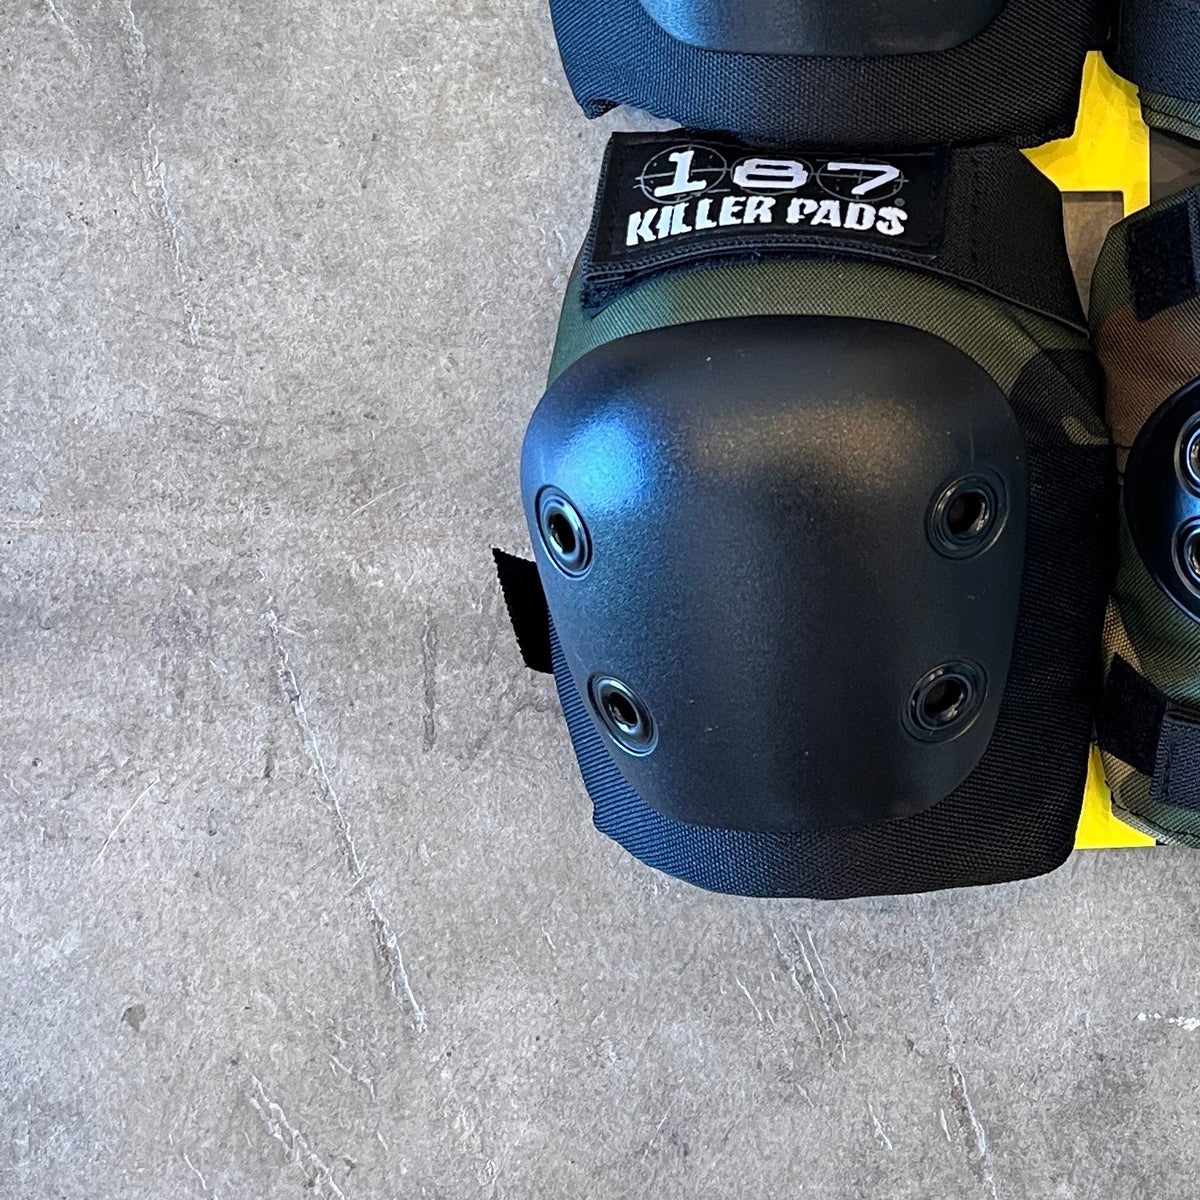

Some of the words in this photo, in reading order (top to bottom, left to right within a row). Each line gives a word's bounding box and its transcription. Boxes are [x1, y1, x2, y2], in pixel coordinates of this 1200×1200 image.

[653, 150, 901, 197] 187
[625, 195, 776, 246] KILLER
[786, 197, 908, 236] PADS
